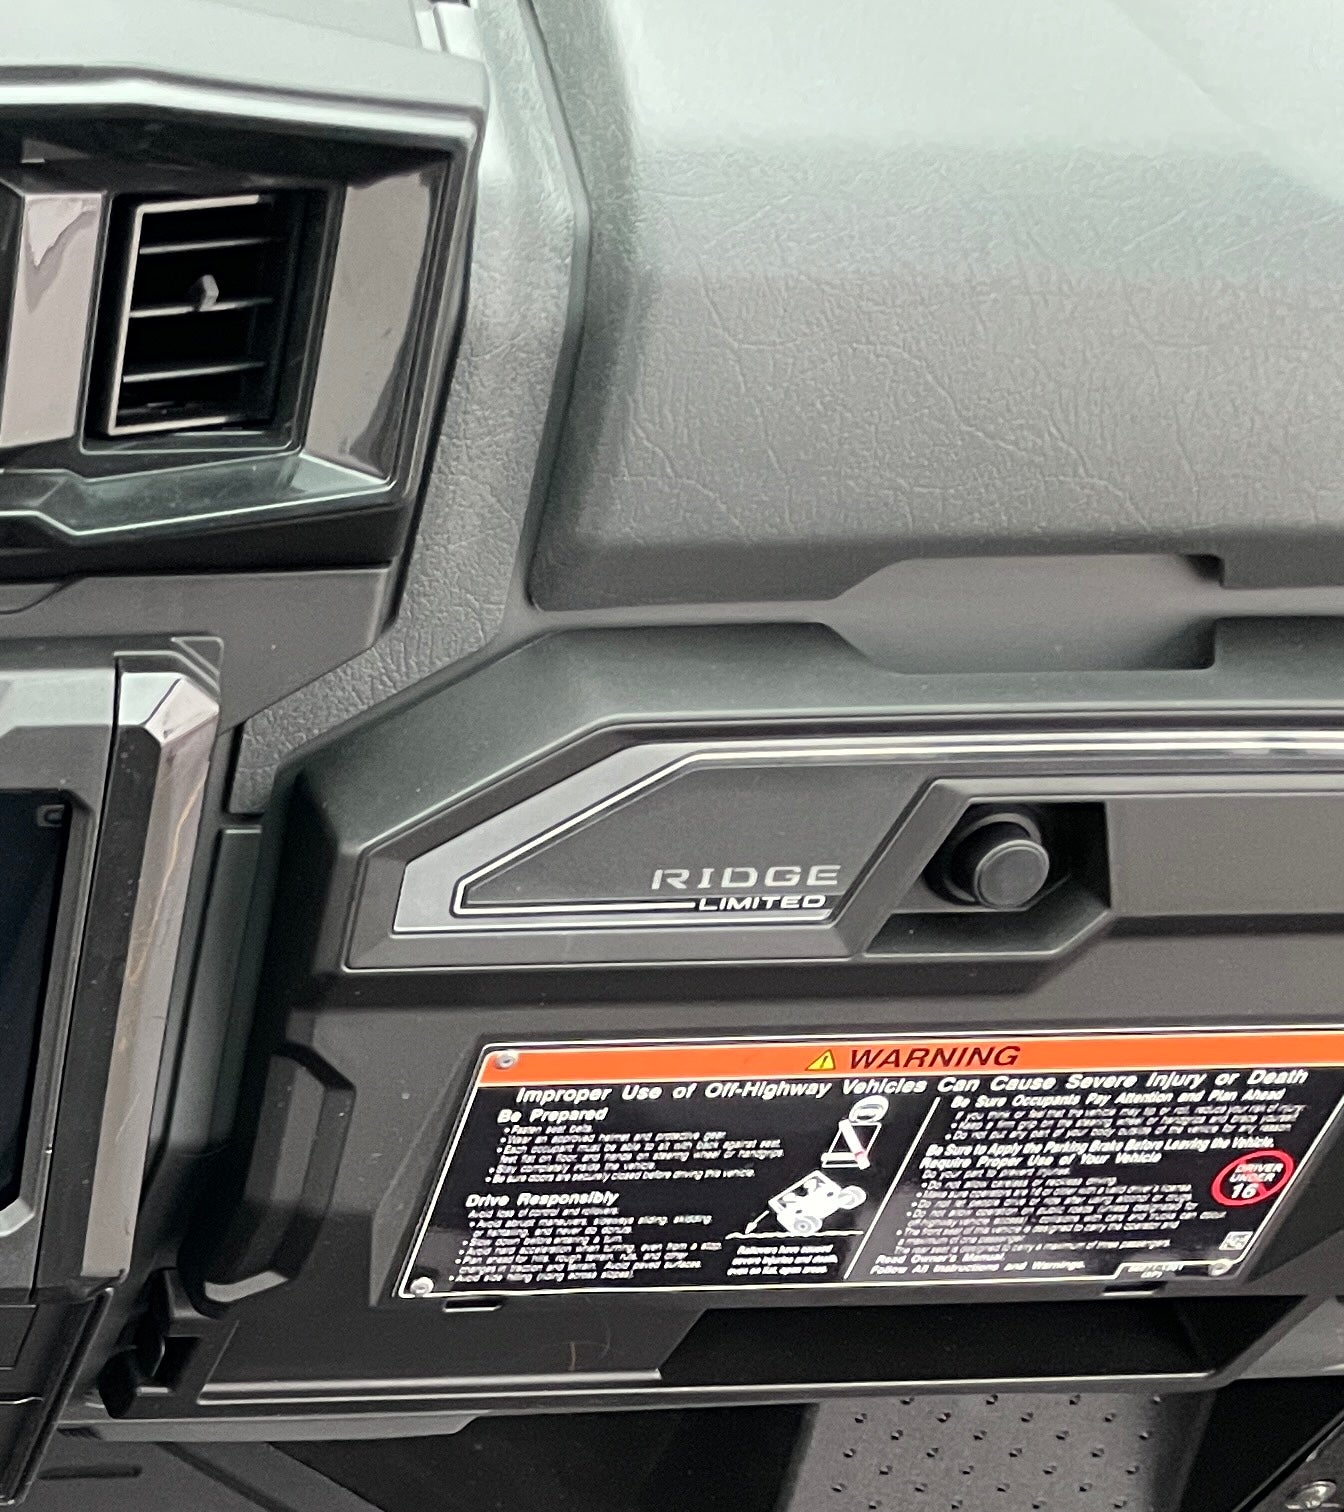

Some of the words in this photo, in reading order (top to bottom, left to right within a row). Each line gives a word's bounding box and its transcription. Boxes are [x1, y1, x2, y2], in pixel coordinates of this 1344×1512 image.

[651, 865, 842, 890] RIDGE
[698, 894, 827, 911] LIMITED
[850, 1046, 1021, 1069] WARNING
[516, 1087, 612, 1106] Improper
[621, 1084, 662, 1100] Use
[672, 1082, 698, 1099] of
[704, 1080, 832, 1100] Off-Highway
[842, 1078, 928, 1095] Vehicles
[937, 1077, 982, 1092] Can
[990, 1075, 1057, 1091] Cause
[1065, 1074, 1138, 1089] Severe
[1146, 1071, 1207, 1090] Injury
[1215, 1072, 1240, 1086] or
[1247, 1069, 1309, 1085] Death
[951, 1096, 971, 1108] Be
[975, 1095, 1008, 1108] Sure
[1012, 1094, 1081, 1108] Occupants
[1085, 1093, 1112, 1107] Pay
[1114, 1091, 1174, 1104] Attention
[1177, 1090, 1206, 1102] and
[1208, 1089, 1238, 1101] Plan
[1241, 1088, 1286, 1101] Ahead
[497, 1109, 522, 1123] Be
[529, 1107, 609, 1124] Prepared
[926, 1144, 944, 1156] Be
[944, 1144, 972, 1156] Sure
[973, 1143, 988, 1155] to
[987, 1143, 1023, 1157] Apply
[1022, 1142, 1043, 1154] the
[1043, 1141, 1089, 1156] Parking
[1210, 1137, 1231, 1149] the
[919, 1156, 972, 1171] Require
[976, 1155, 1024, 1170] Proper
[1027, 1154, 1054, 1167] Use
[1080, 1152, 1111, 1165] Your
[1115, 1151, 1162, 1164] Vehicle
[1235, 1163, 1284, 1174] DRIVER
[1230, 1173, 1276, 1183] UNDER
[465, 1194, 510, 1208] Drive
[517, 1190, 619, 1208] Responsibly
[1232, 1182, 1259, 1199] 16
